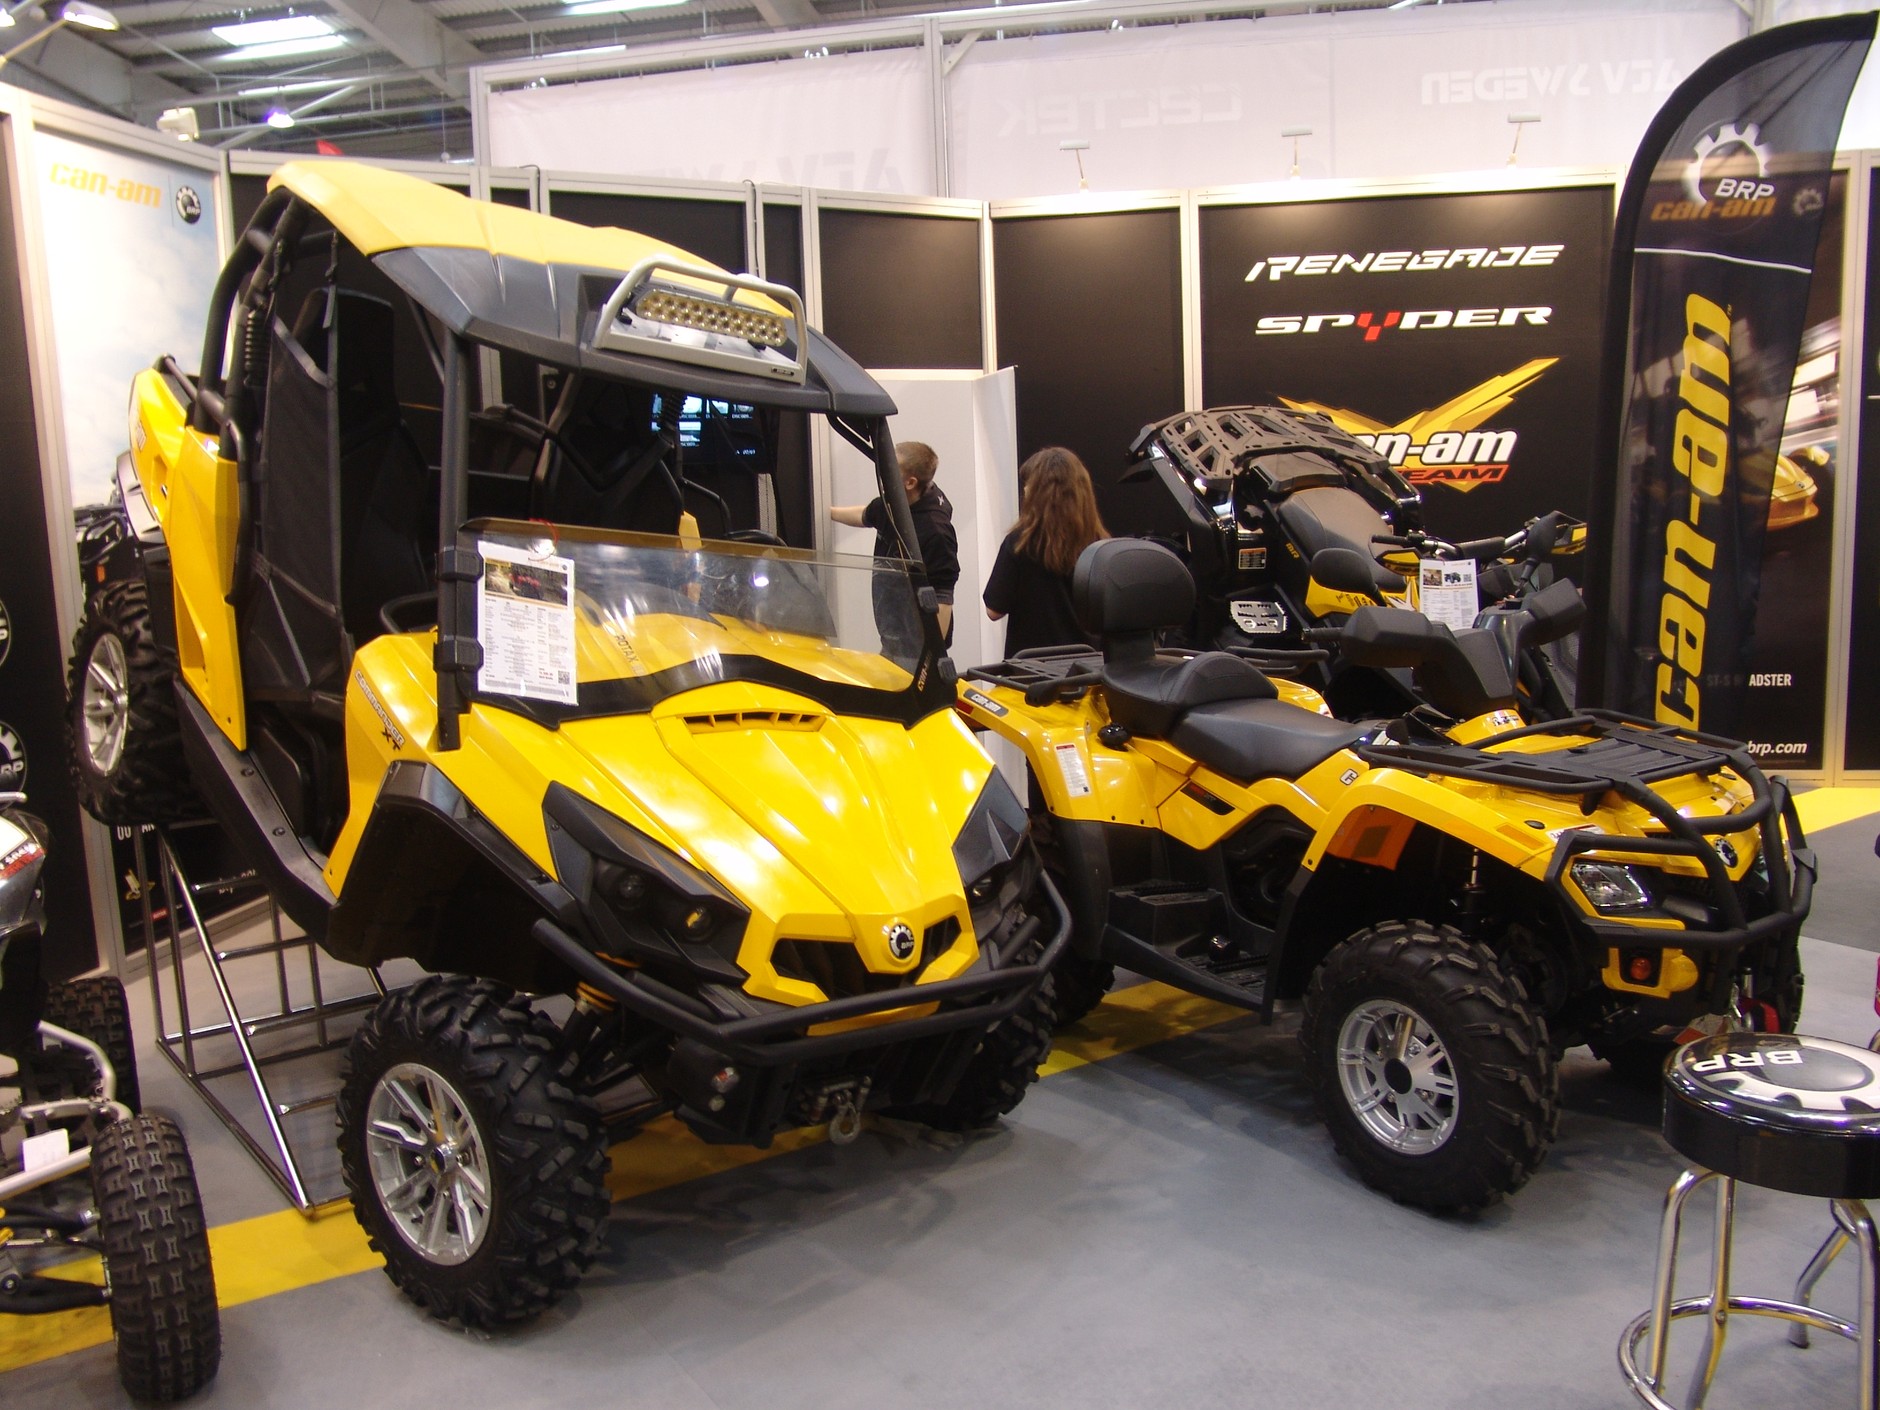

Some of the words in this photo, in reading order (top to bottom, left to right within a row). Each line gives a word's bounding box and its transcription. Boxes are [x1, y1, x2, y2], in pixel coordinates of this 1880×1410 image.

[49, 162, 164, 208] can-am
[1714, 178, 1775, 201] BRP
[1650, 197, 1778, 221] can-am
[1245, 244, 1565, 282] RENEGADE
[1255, 306, 1552, 341] SPYDER
[1354, 430, 1518, 465] n-am
[1397, 467, 1503, 481] EAM
[1655, 293, 1732, 732] can-am
[355, 669, 405, 747] COMMANDER
[381, 727, 402, 751] XT
[0, 760, 24, 776] RP
[1692, 1050, 1804, 1073] BRP
